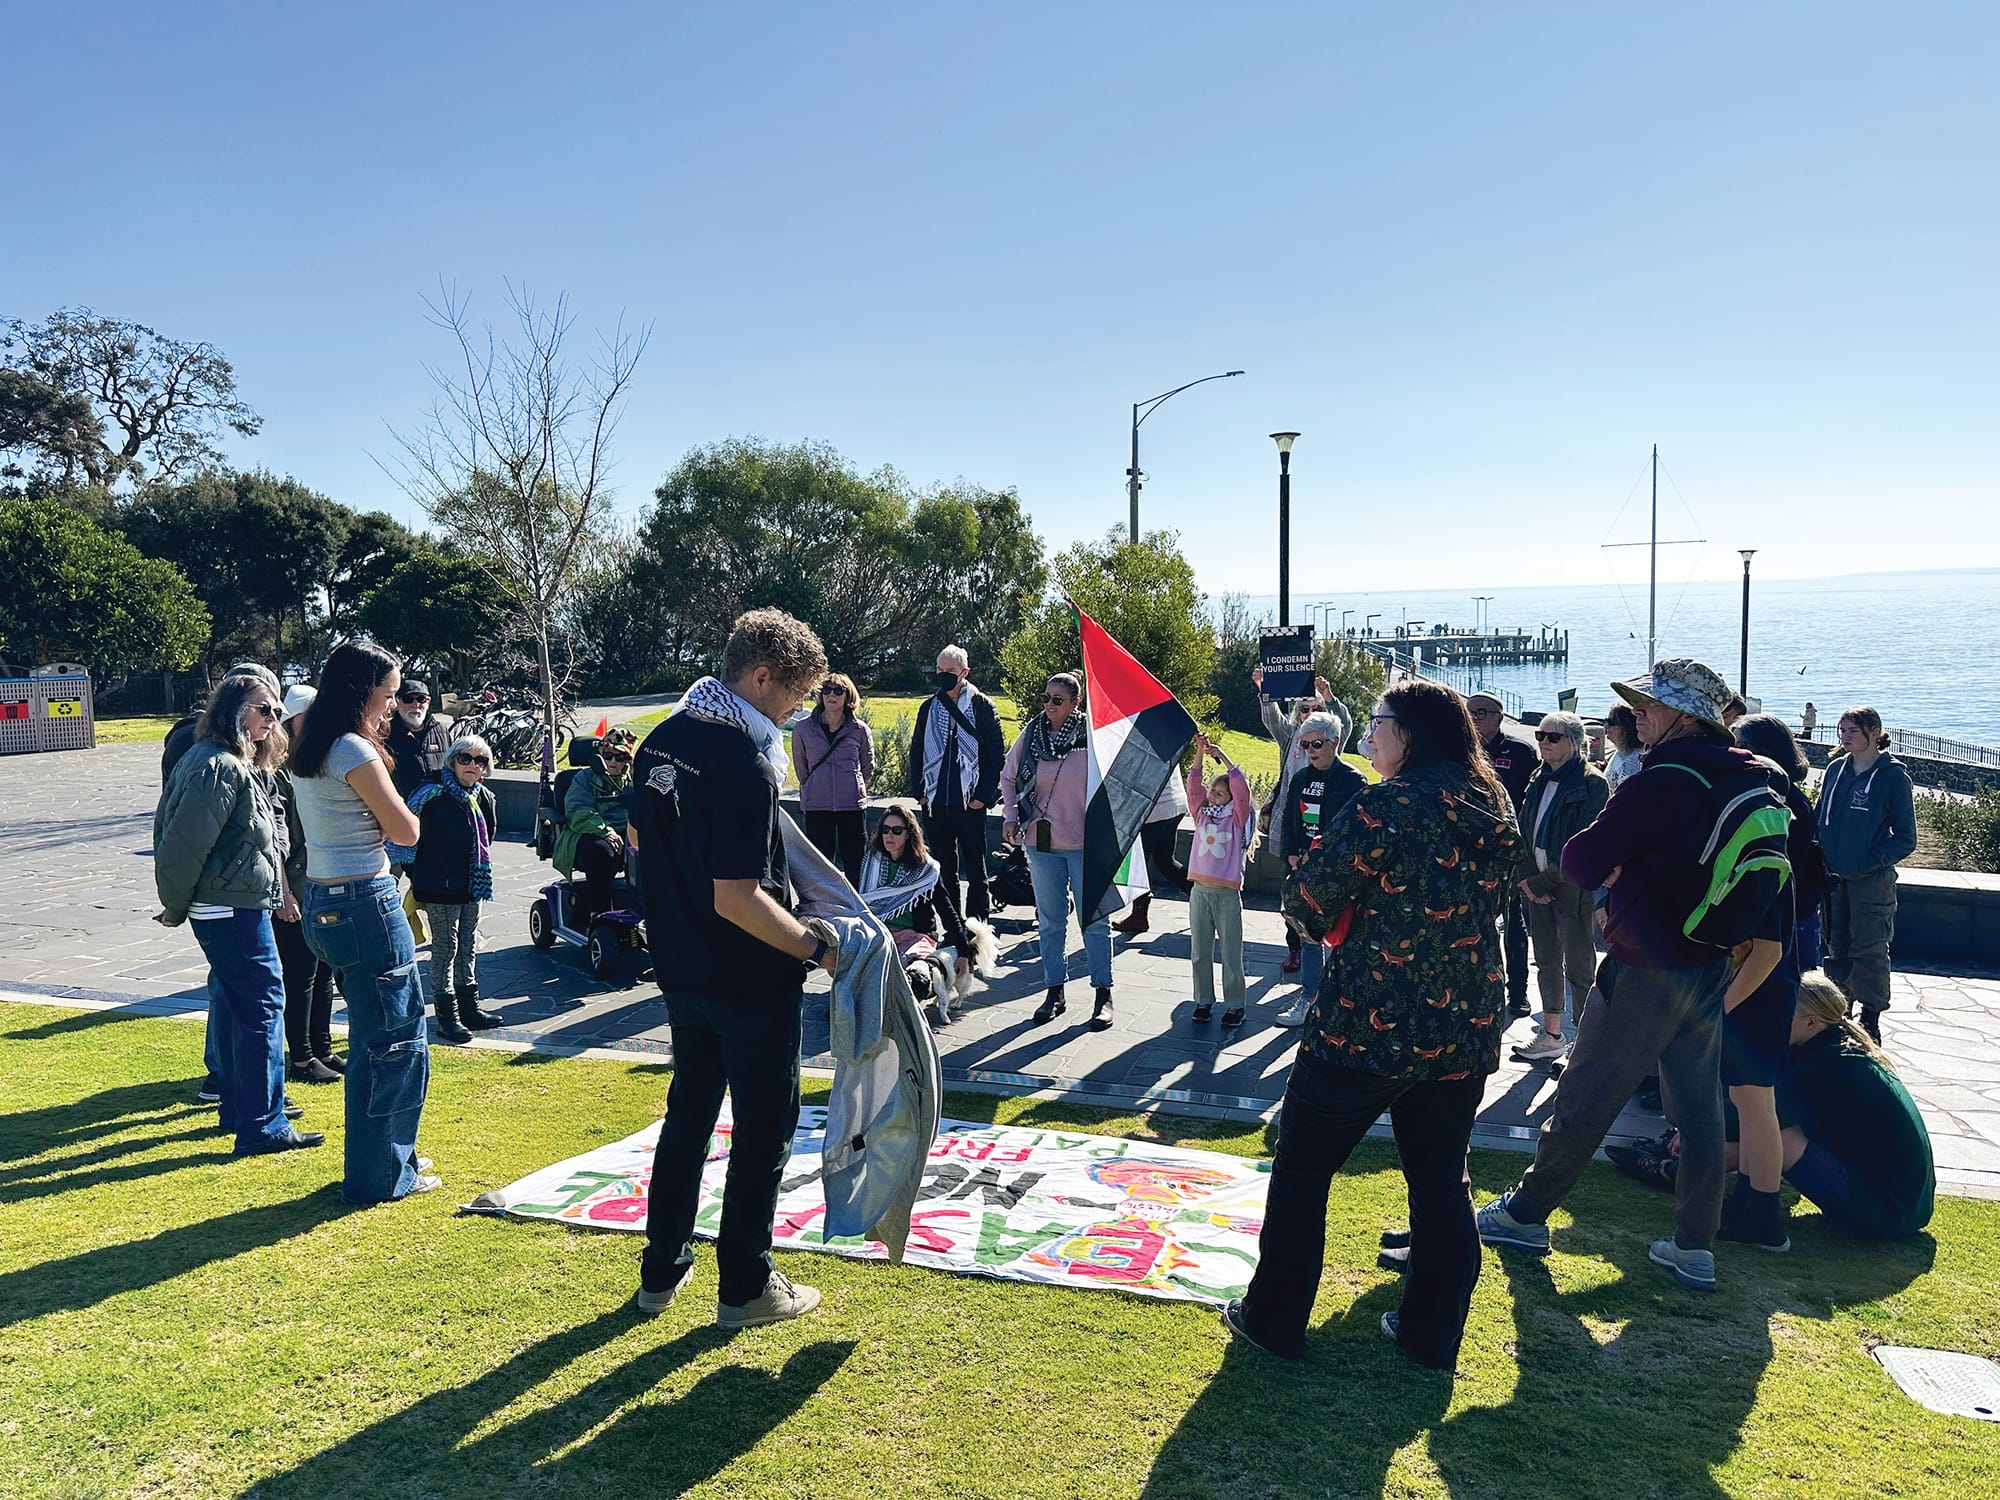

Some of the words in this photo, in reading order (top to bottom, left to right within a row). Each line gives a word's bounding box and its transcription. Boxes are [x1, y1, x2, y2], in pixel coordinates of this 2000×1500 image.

[1266, 656, 1270, 665] I
[1271, 655, 1308, 664] CONDEMN
[1263, 664, 1283, 673] YOUR
[1284, 663, 1316, 672] SILENCE
